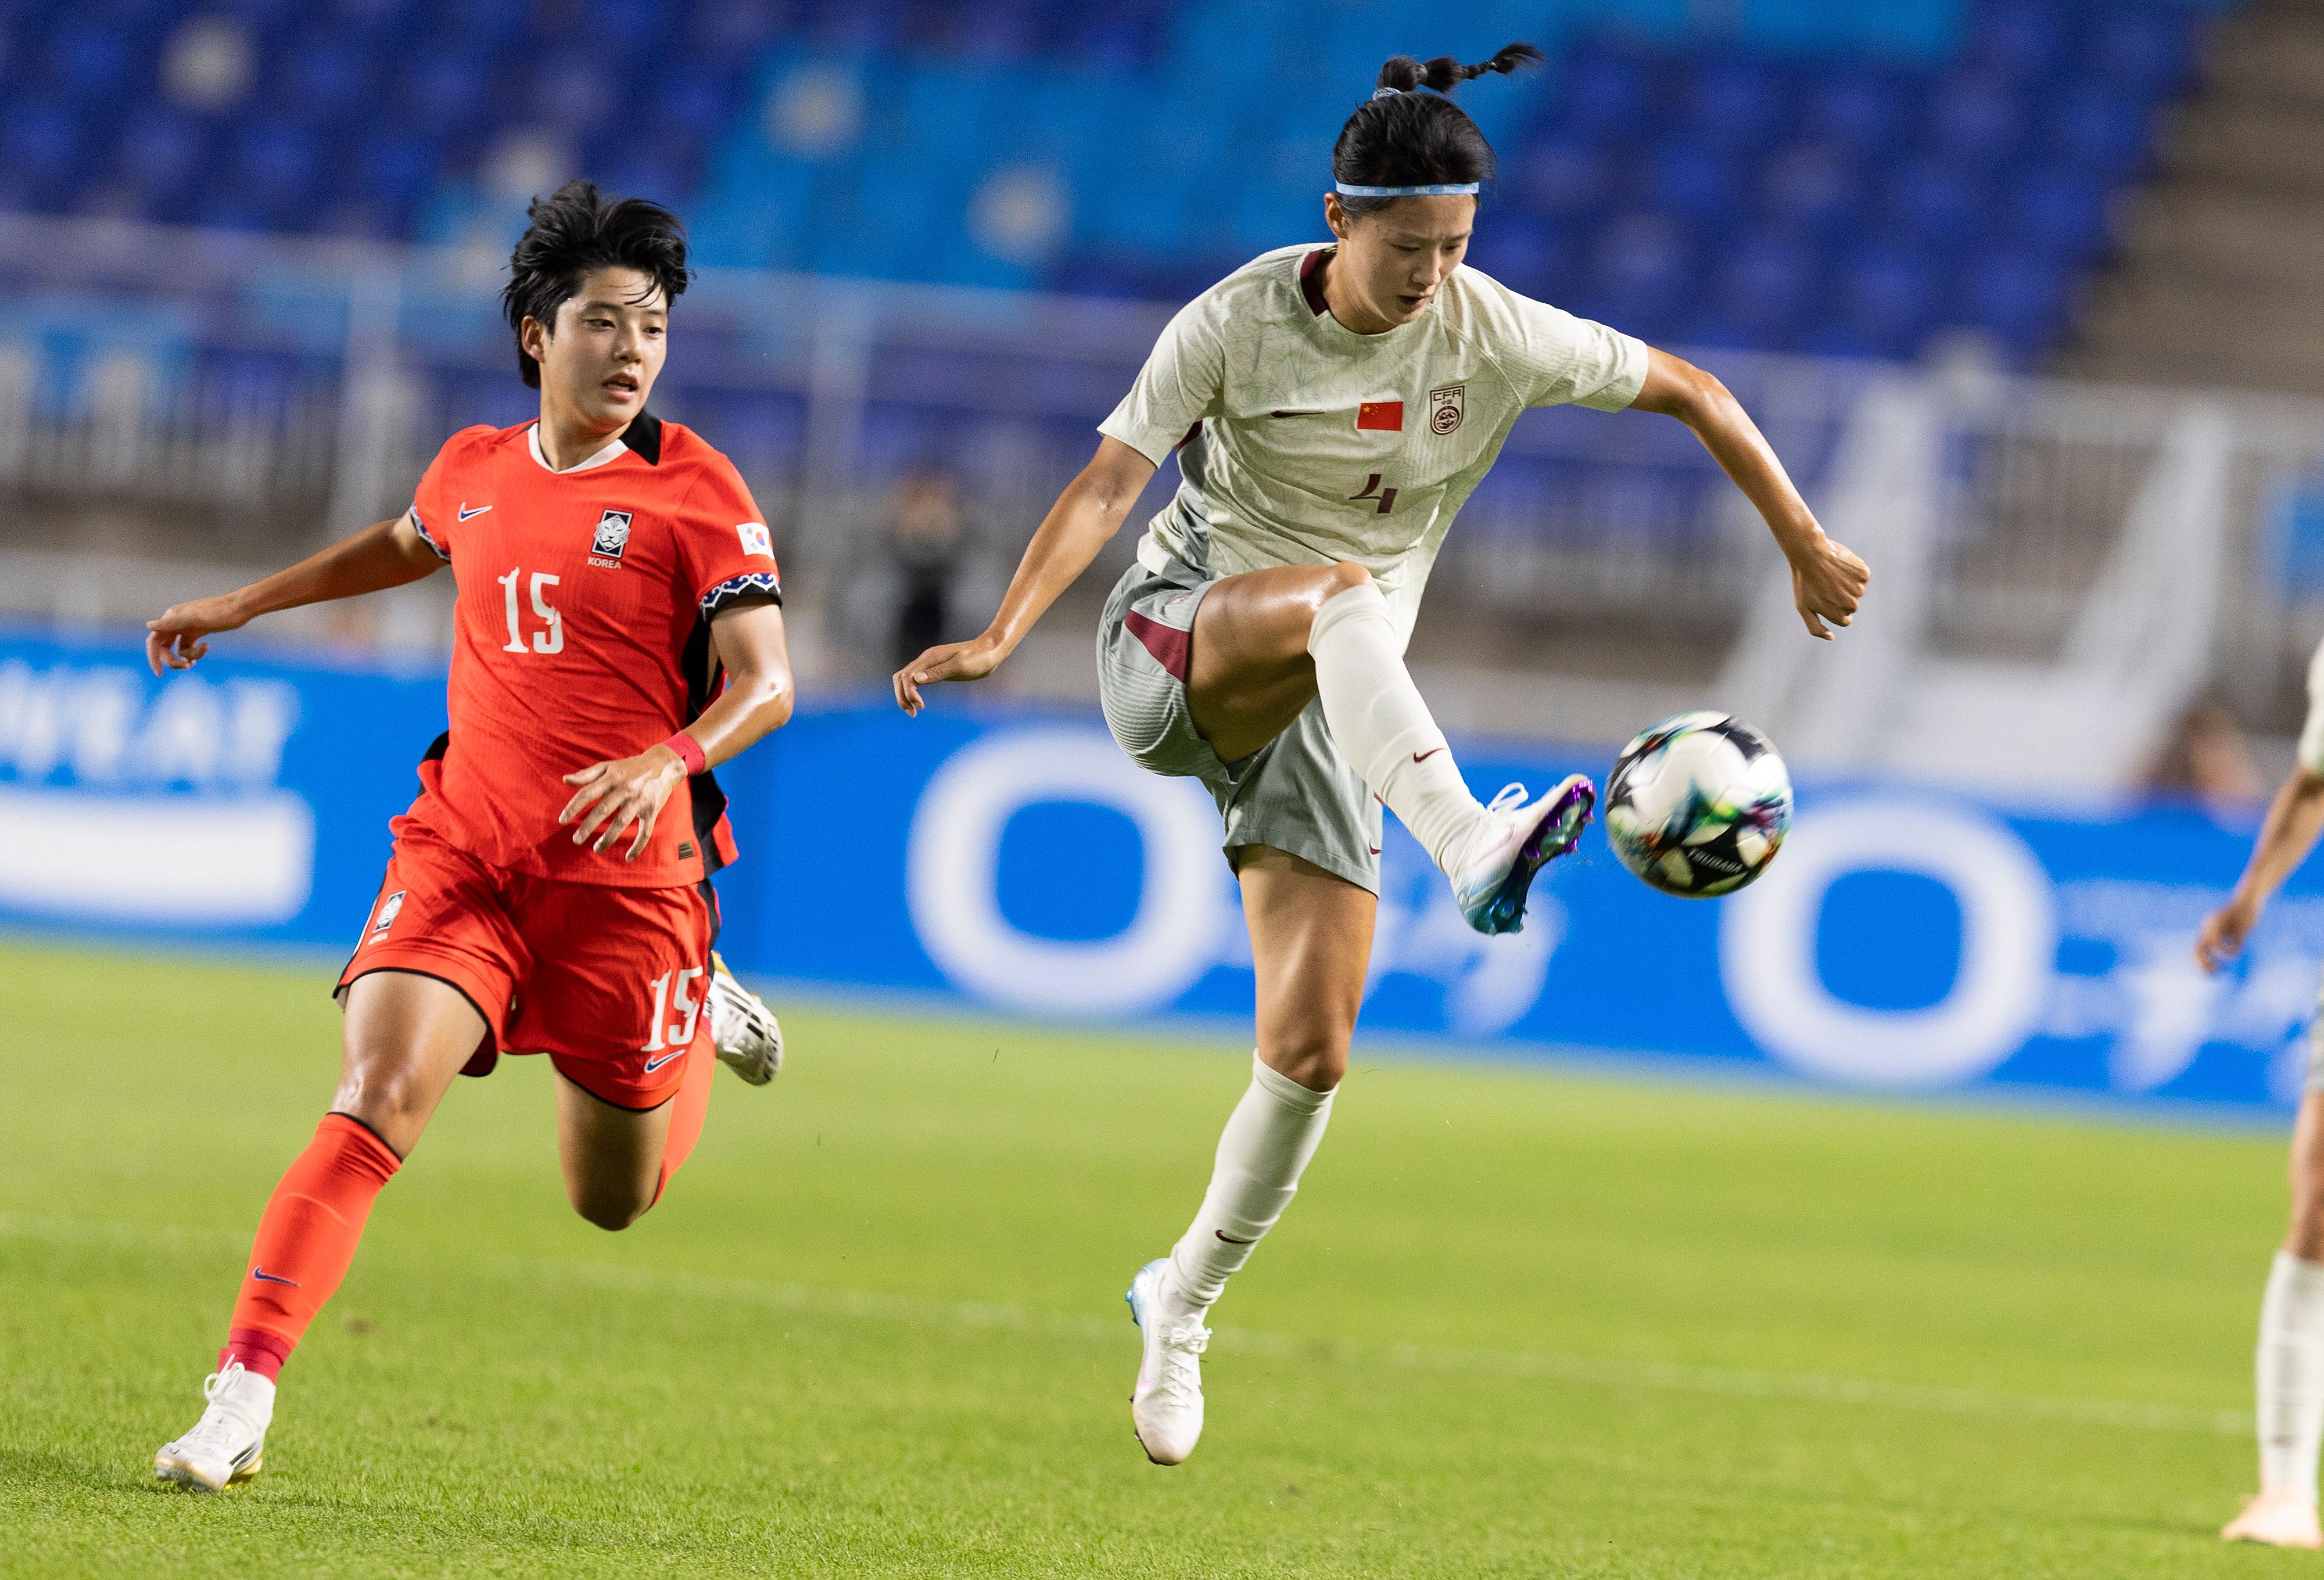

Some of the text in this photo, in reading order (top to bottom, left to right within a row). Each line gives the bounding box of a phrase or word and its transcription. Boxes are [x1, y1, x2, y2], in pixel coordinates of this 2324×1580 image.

[1433, 389, 1461, 401] CFA
[1348, 473, 1398, 514] 4
[587, 556, 622, 569] KOREA
[497, 566, 564, 654] 15
[640, 965, 704, 1052] 15
